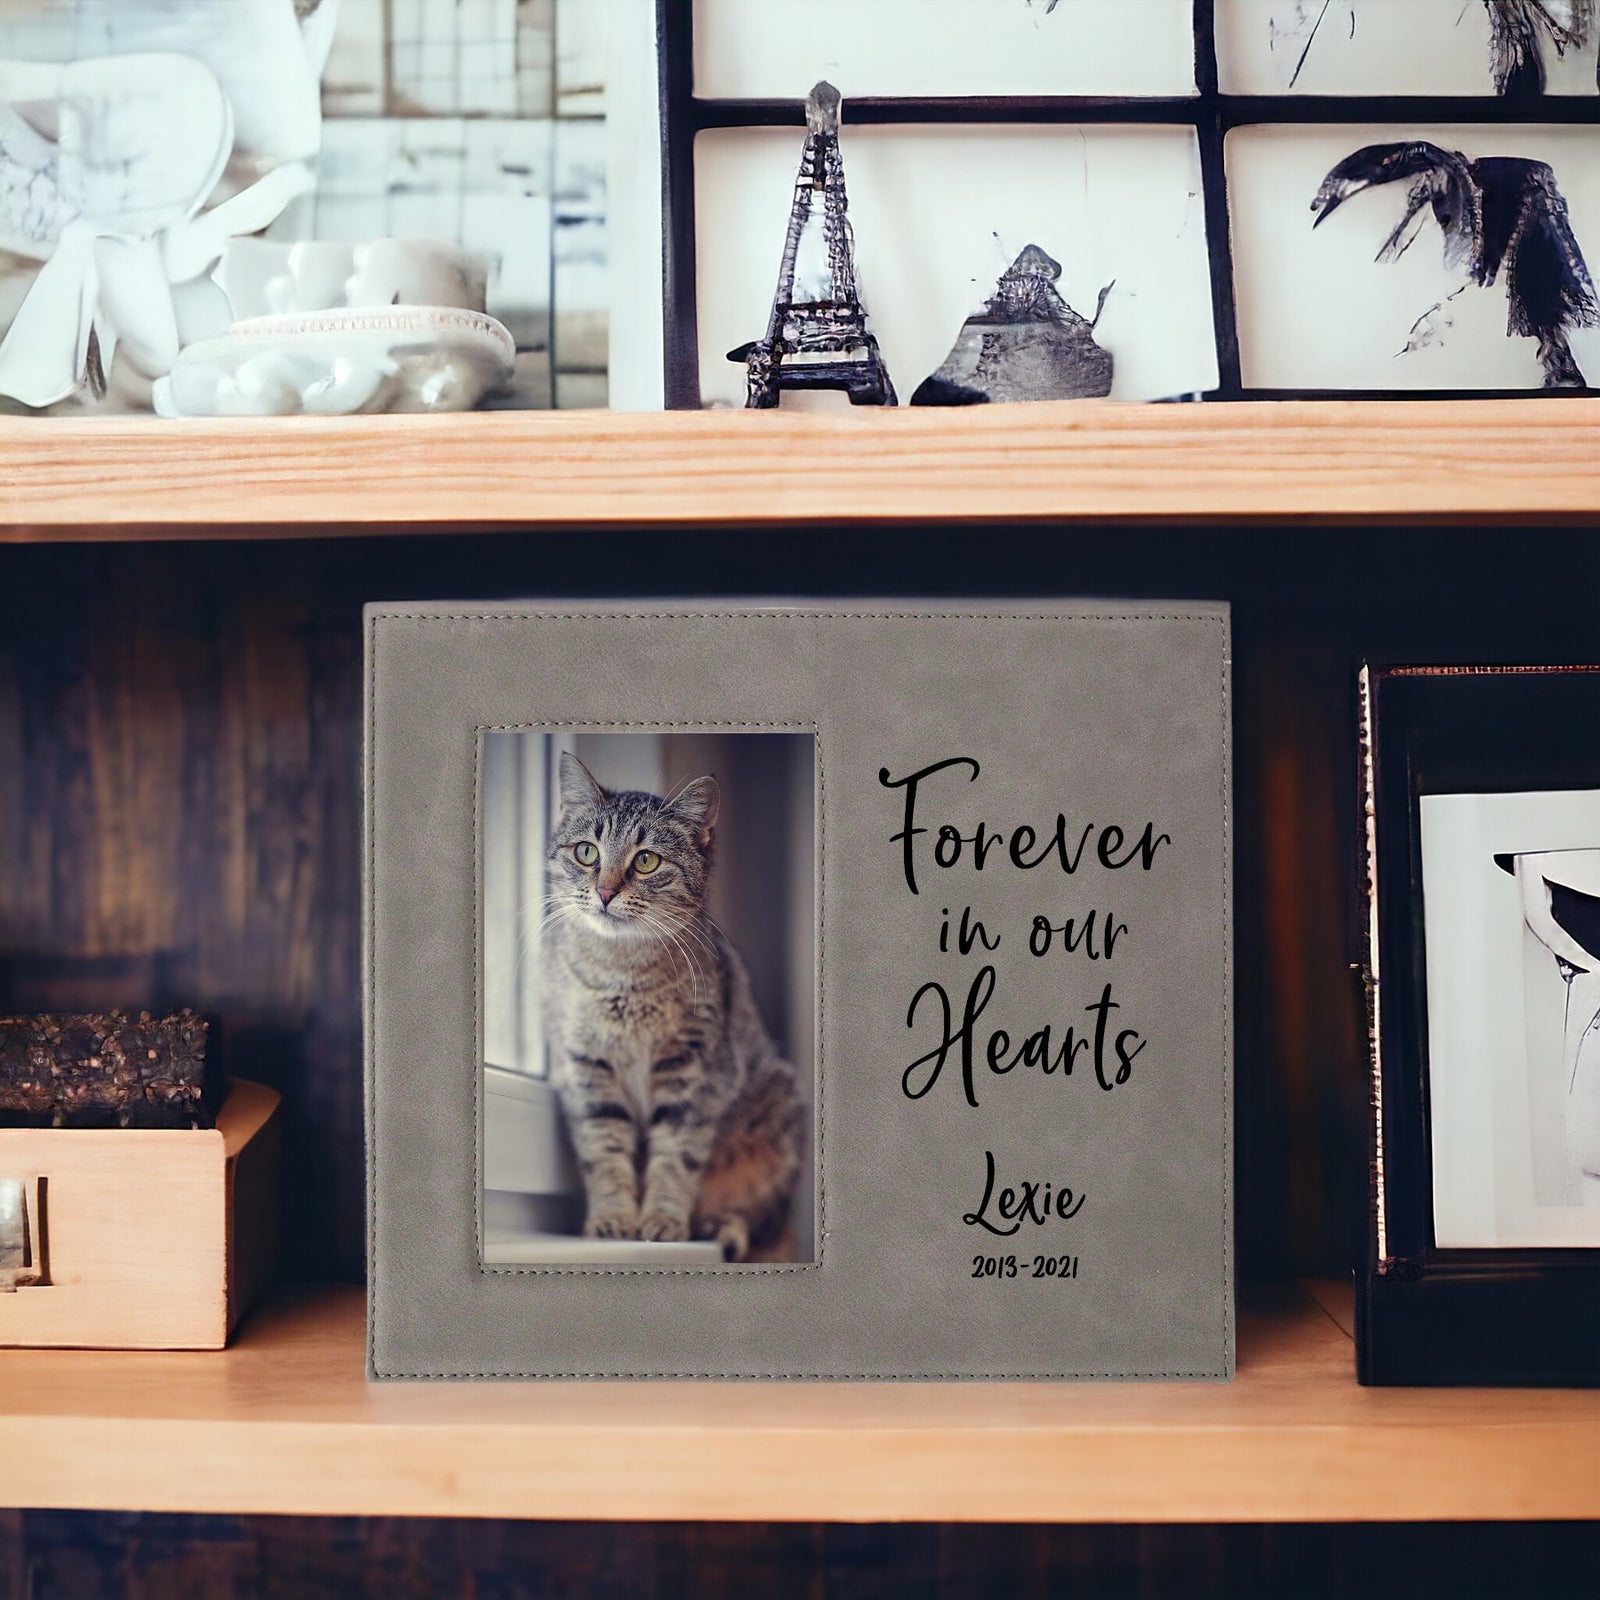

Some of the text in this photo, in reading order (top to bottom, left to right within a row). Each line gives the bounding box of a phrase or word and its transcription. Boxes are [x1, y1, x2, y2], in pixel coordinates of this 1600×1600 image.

[879, 757, 1172, 895] Forever
[939, 907, 1129, 960] in our
[902, 965, 1147, 1107] Hearts
[962, 1150, 1086, 1237] Lexie
[971, 1255, 1079, 1279] 2013-2021
